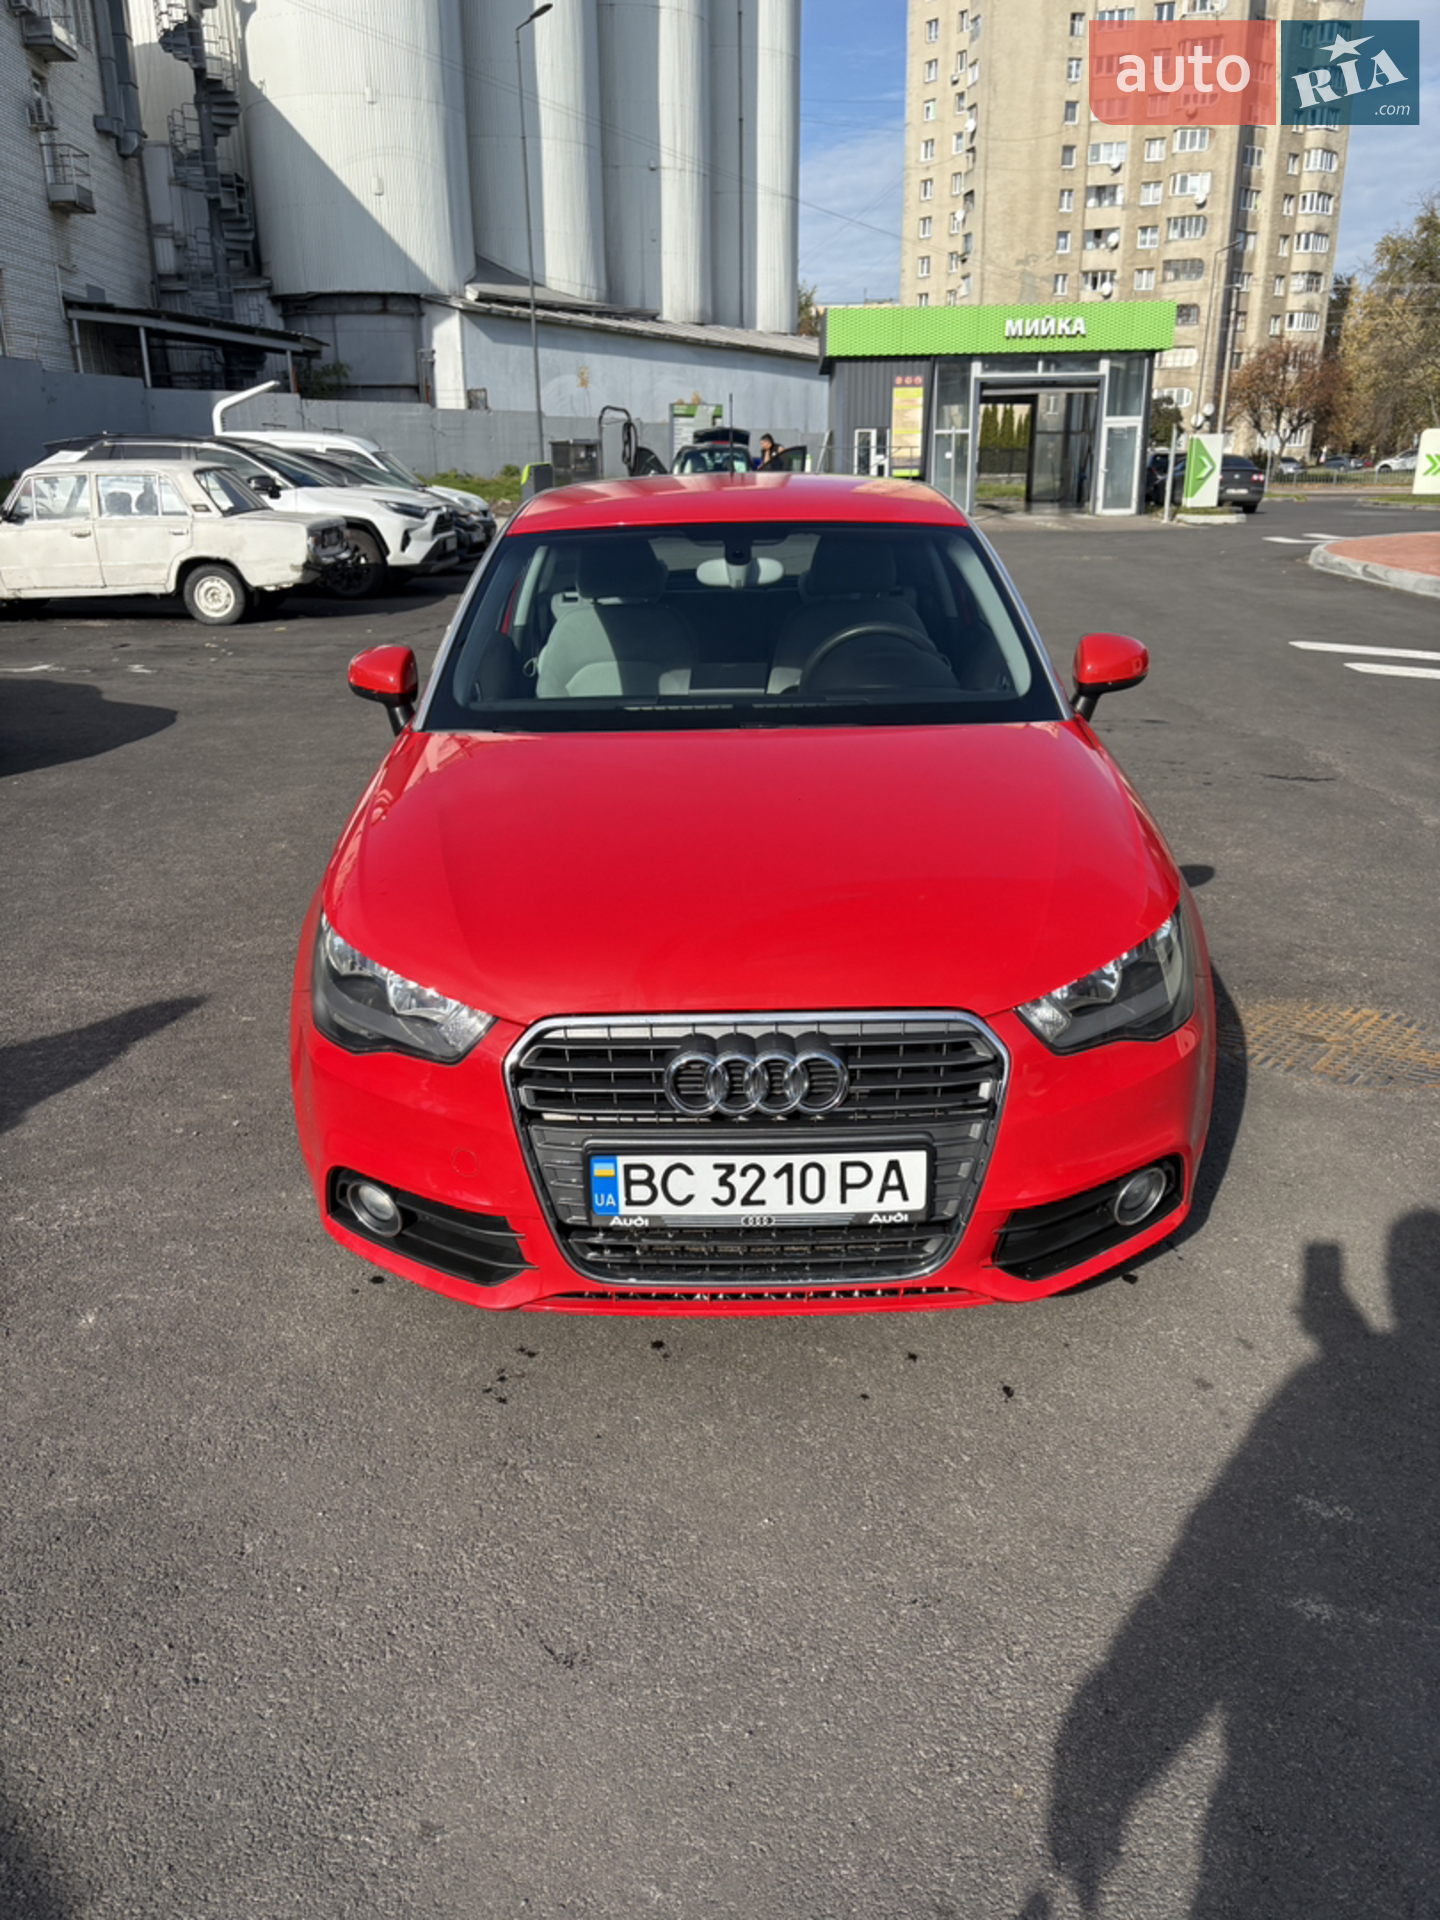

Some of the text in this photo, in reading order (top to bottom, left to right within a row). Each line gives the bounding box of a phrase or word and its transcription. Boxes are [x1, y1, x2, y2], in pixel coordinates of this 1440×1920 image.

[1004, 315, 1085, 338] МИЙКА
[623, 1159, 909, 1207] BC 3210 PA
[594, 1193, 617, 1208] UA
